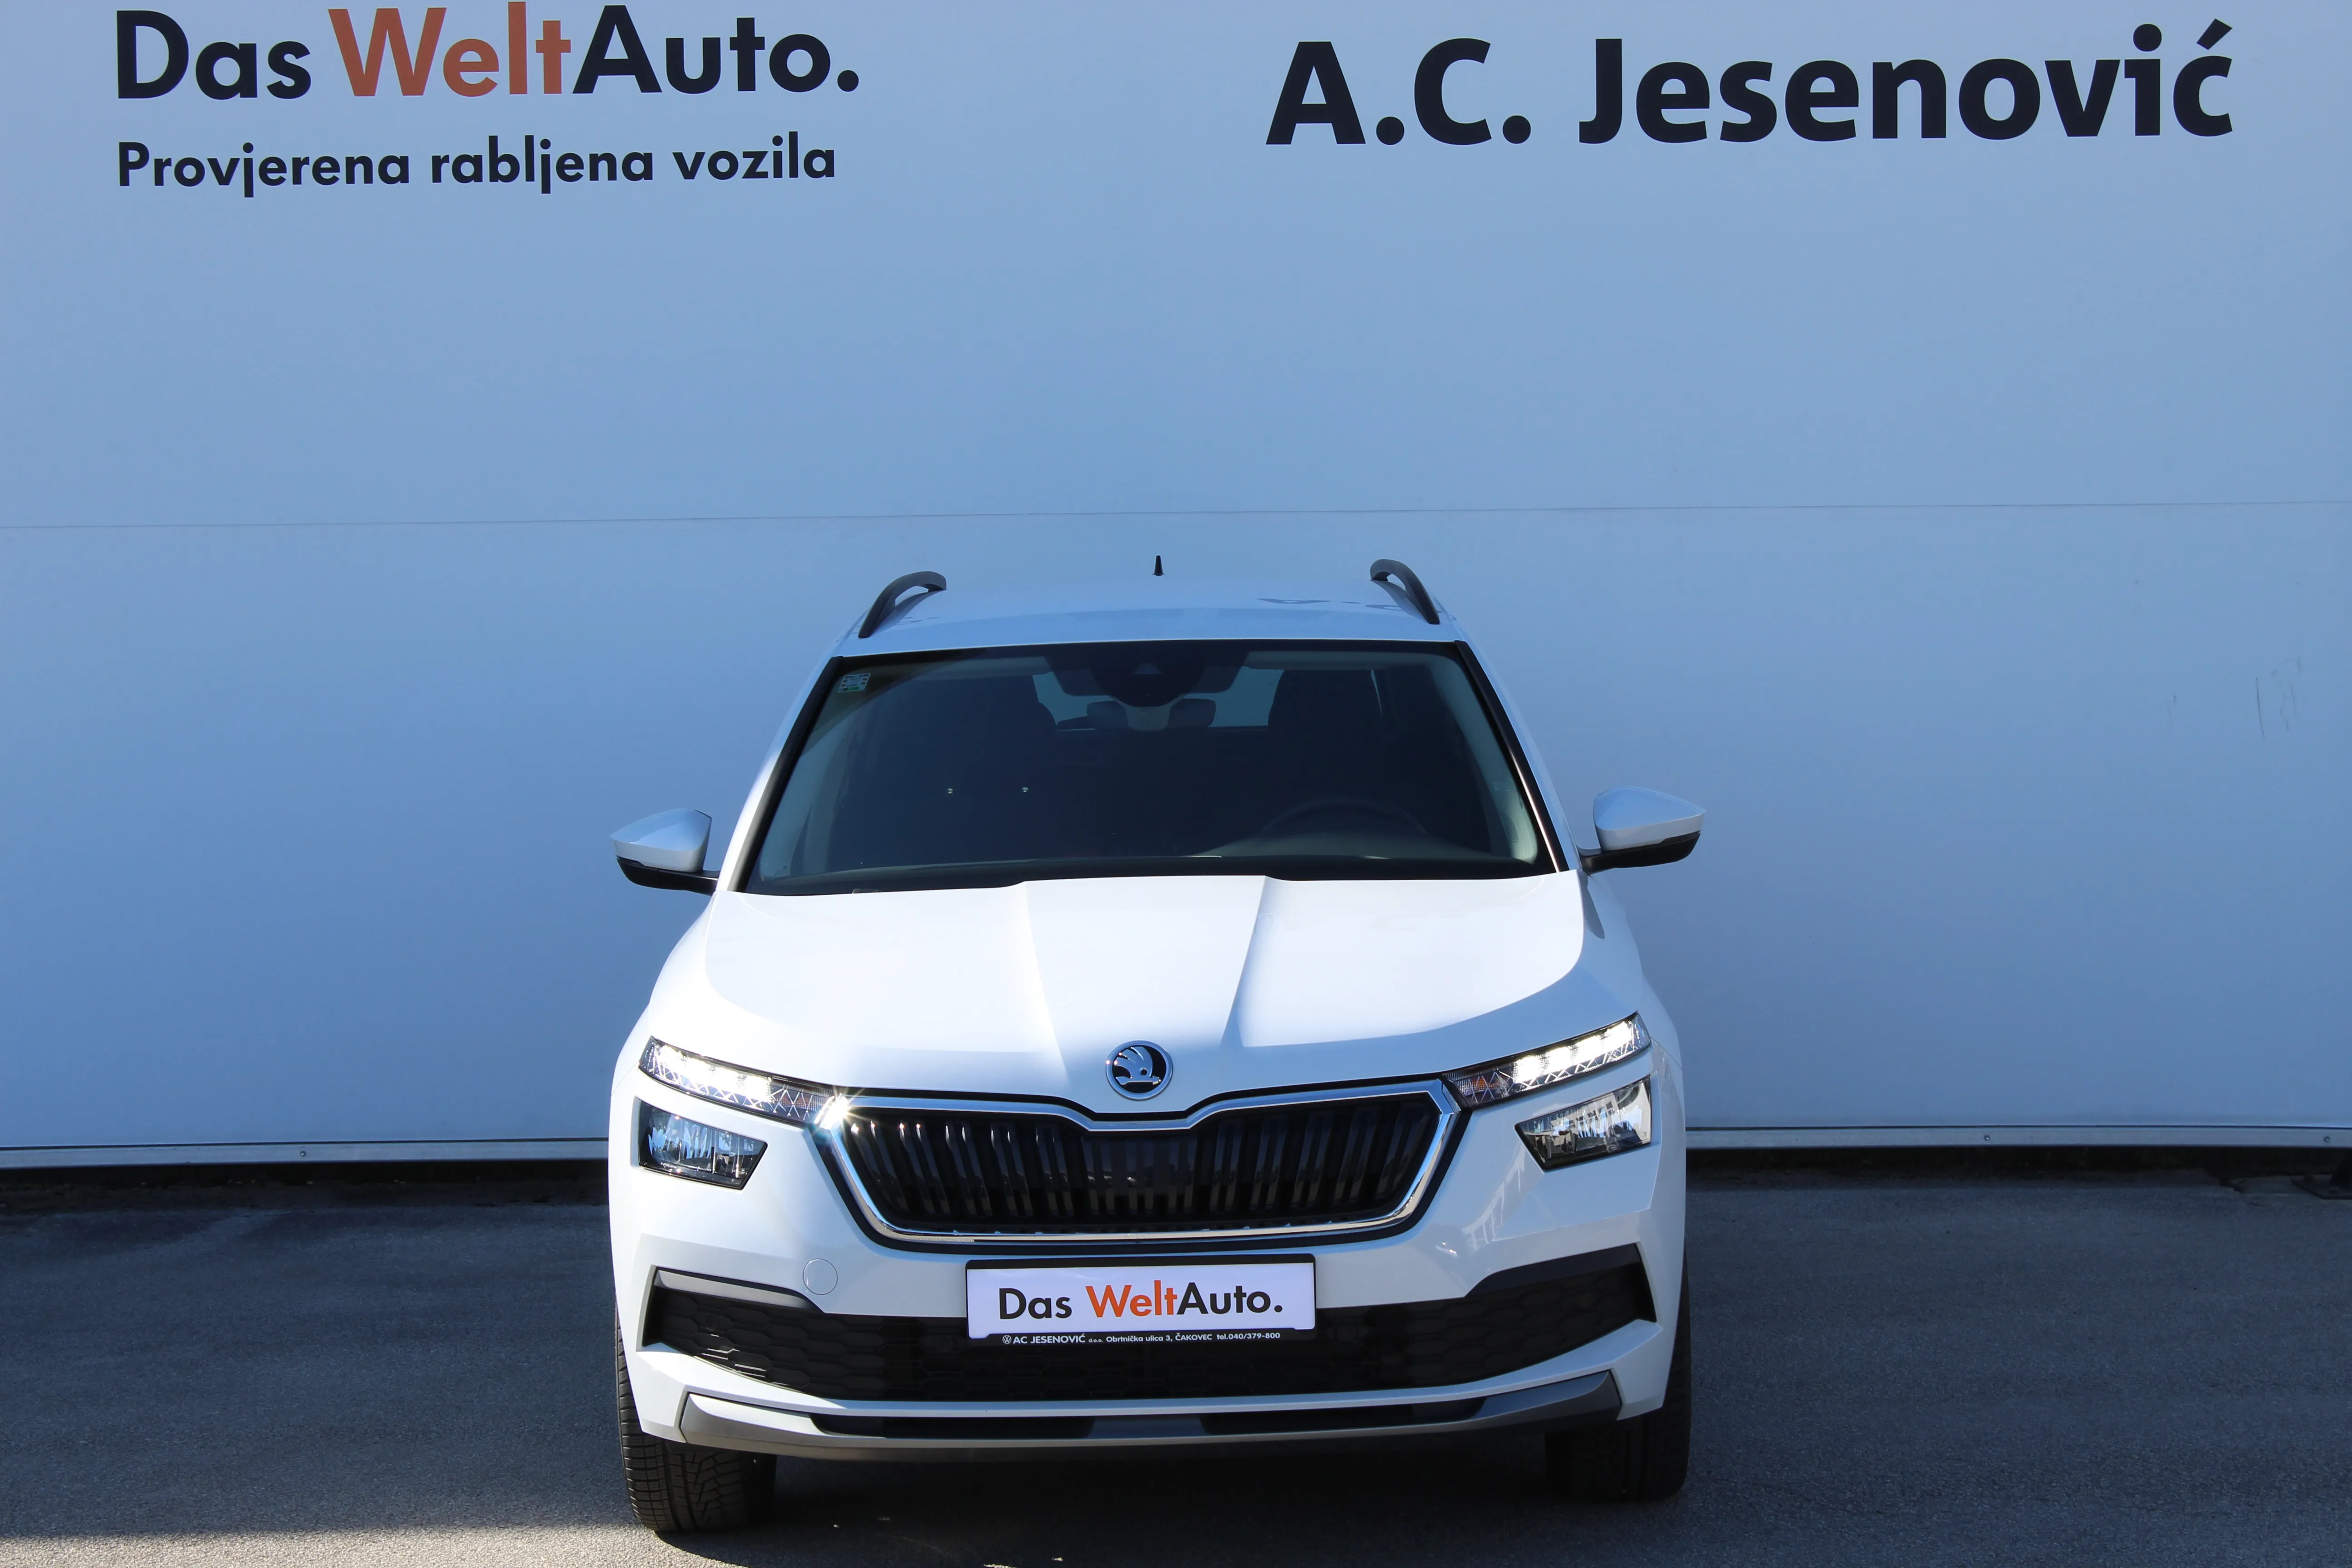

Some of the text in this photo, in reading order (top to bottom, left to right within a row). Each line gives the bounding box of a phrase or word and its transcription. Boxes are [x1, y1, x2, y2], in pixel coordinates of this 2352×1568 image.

[116, 1, 859, 100] Das WeltAuto.
[1265, 18, 2233, 146] A.C. Jesenović
[118, 131, 835, 198] Provjerena rabljena vozila
[999, 1279, 1284, 1320] Das WeltAuto.
[1013, 1336, 1028, 1344] AC
[1030, 1333, 1086, 1344] JESENOVIĆ
[1106, 1335, 1143, 1343] Obrtnička
[1165, 1334, 1173, 1343] 3,
[1175, 1332, 1213, 1341] ČAKOVEC
[1216, 1332, 1281, 1340] tel.040/379-800
